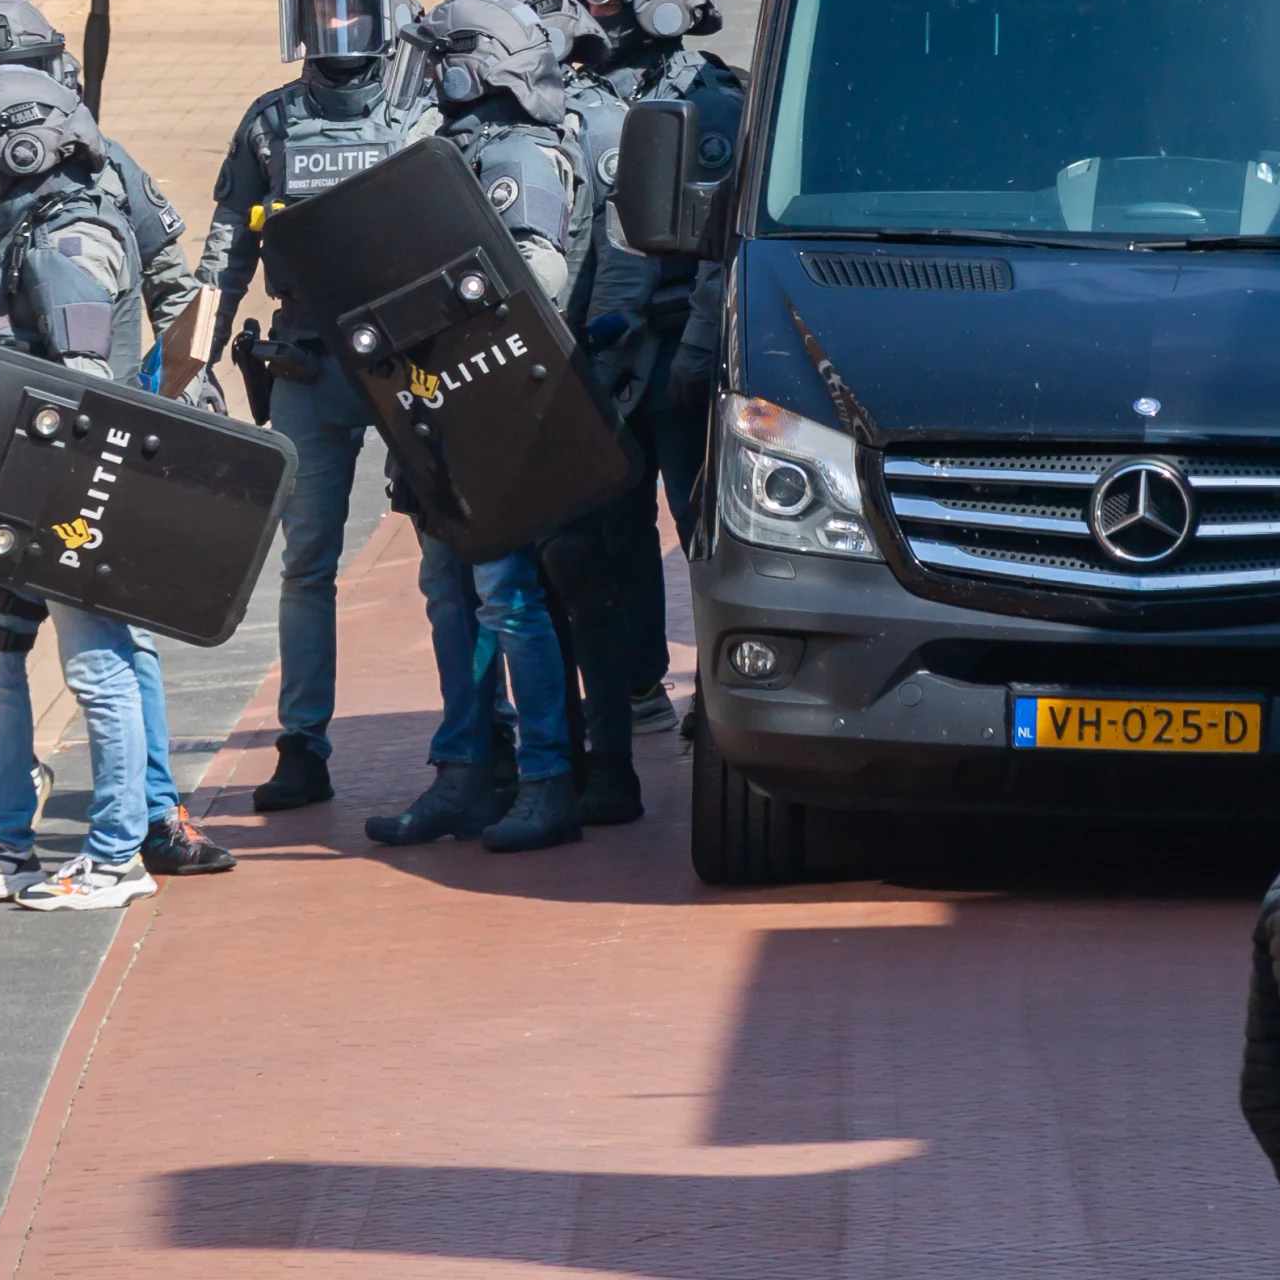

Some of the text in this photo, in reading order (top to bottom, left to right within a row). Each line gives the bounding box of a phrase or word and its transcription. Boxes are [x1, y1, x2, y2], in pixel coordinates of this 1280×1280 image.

[294, 151, 380, 174] POLITIE
[396, 333, 528, 411] POLITIE
[59, 428, 131, 568] POLITIE
[1018, 727, 1034, 739] NL
[1048, 706, 1248, 746] VH-025-D
